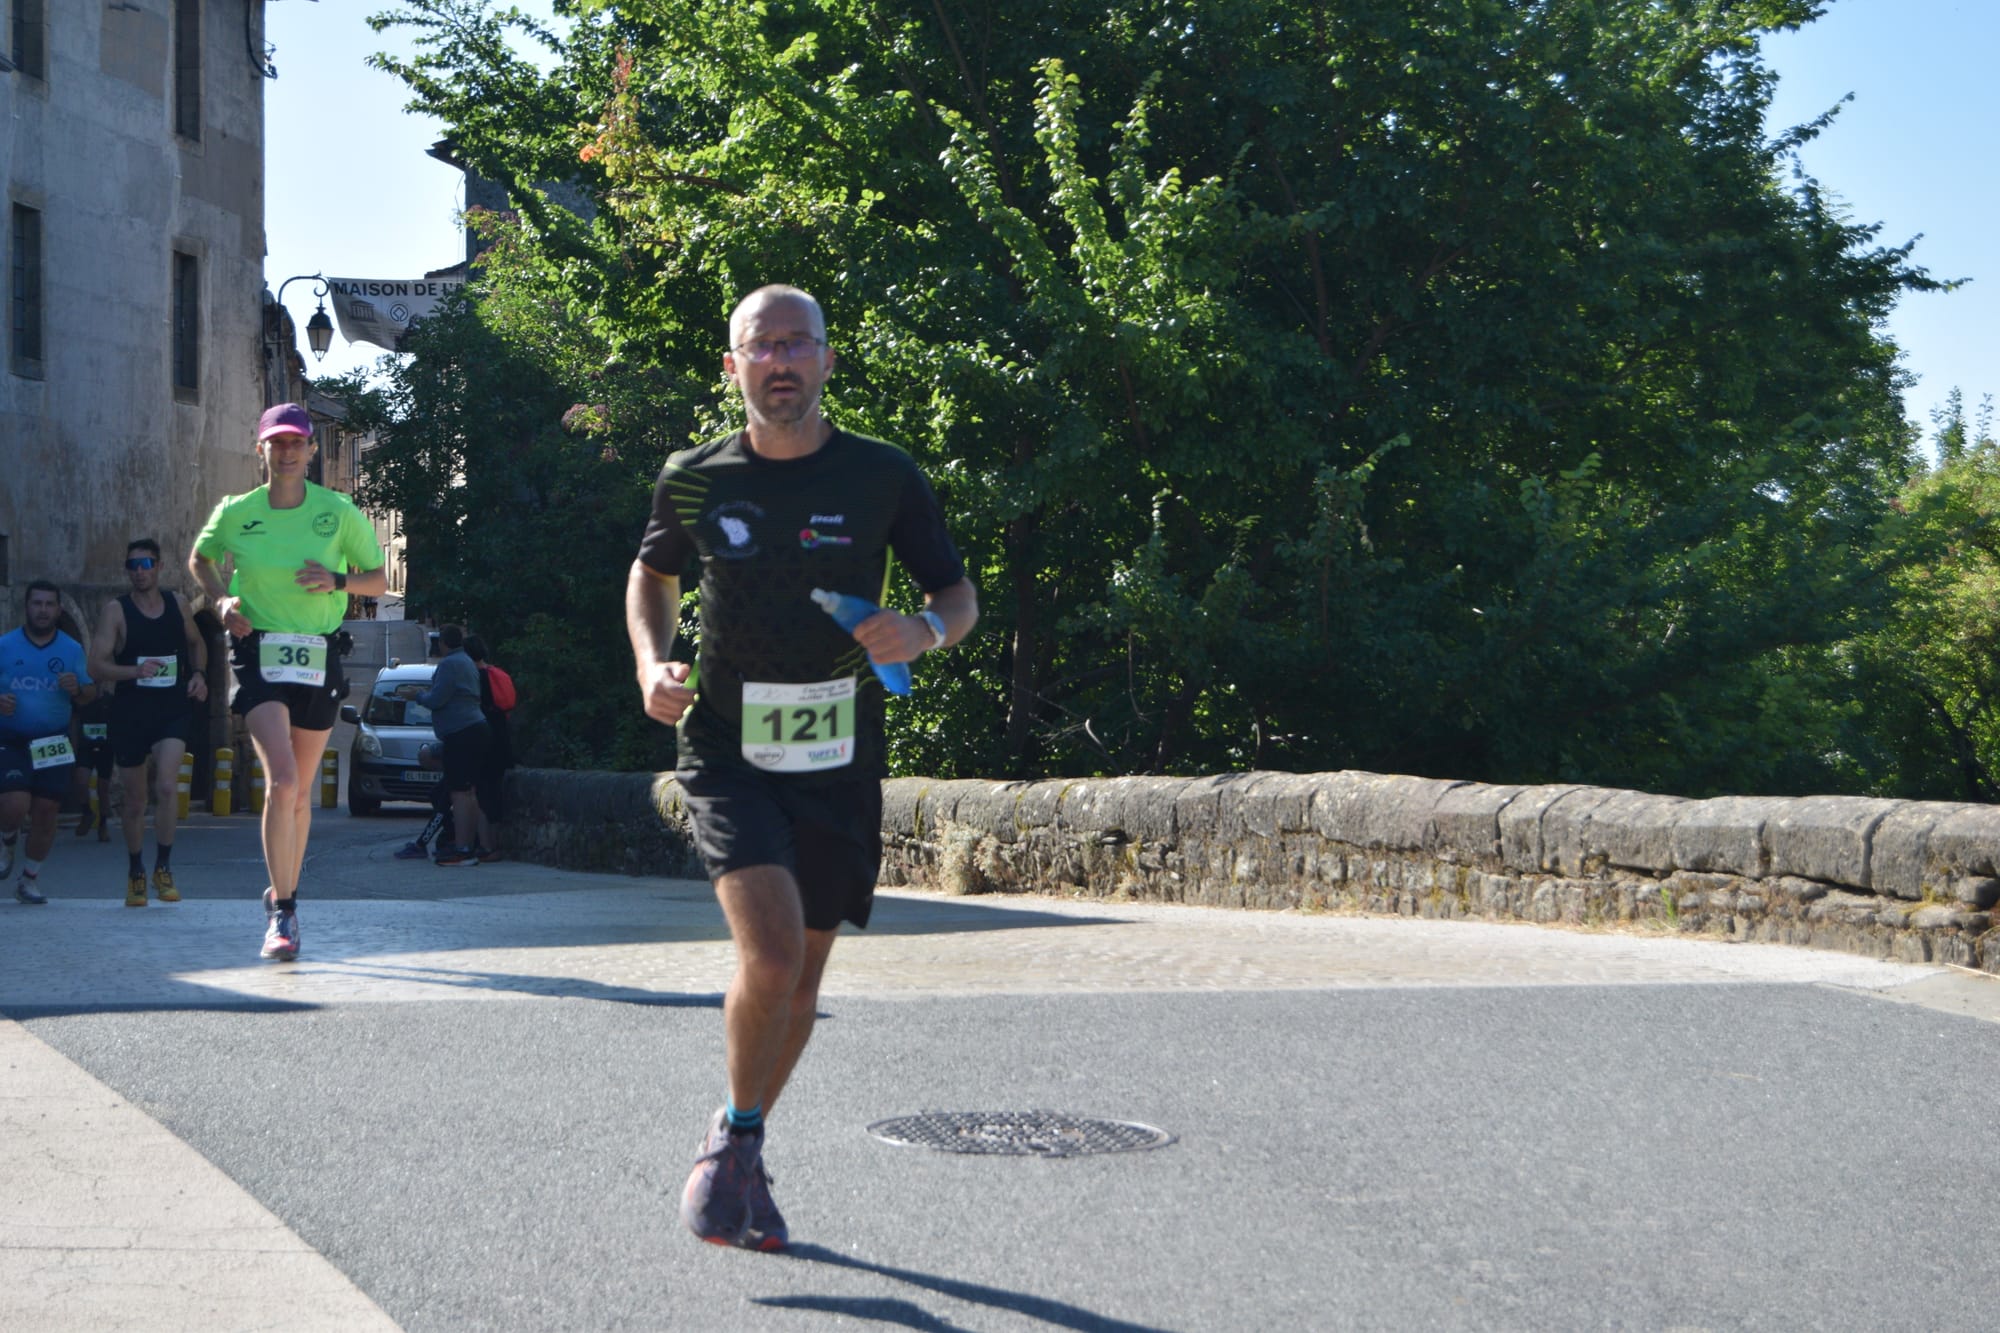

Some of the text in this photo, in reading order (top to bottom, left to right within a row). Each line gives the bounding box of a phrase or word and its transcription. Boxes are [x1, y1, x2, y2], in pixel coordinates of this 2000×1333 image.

[334, 282, 408, 297] MAISON
[414, 283, 438, 296] DE
[278, 645, 310, 666] 36
[762, 703, 838, 742] 121
[38, 742, 68, 758] 138
